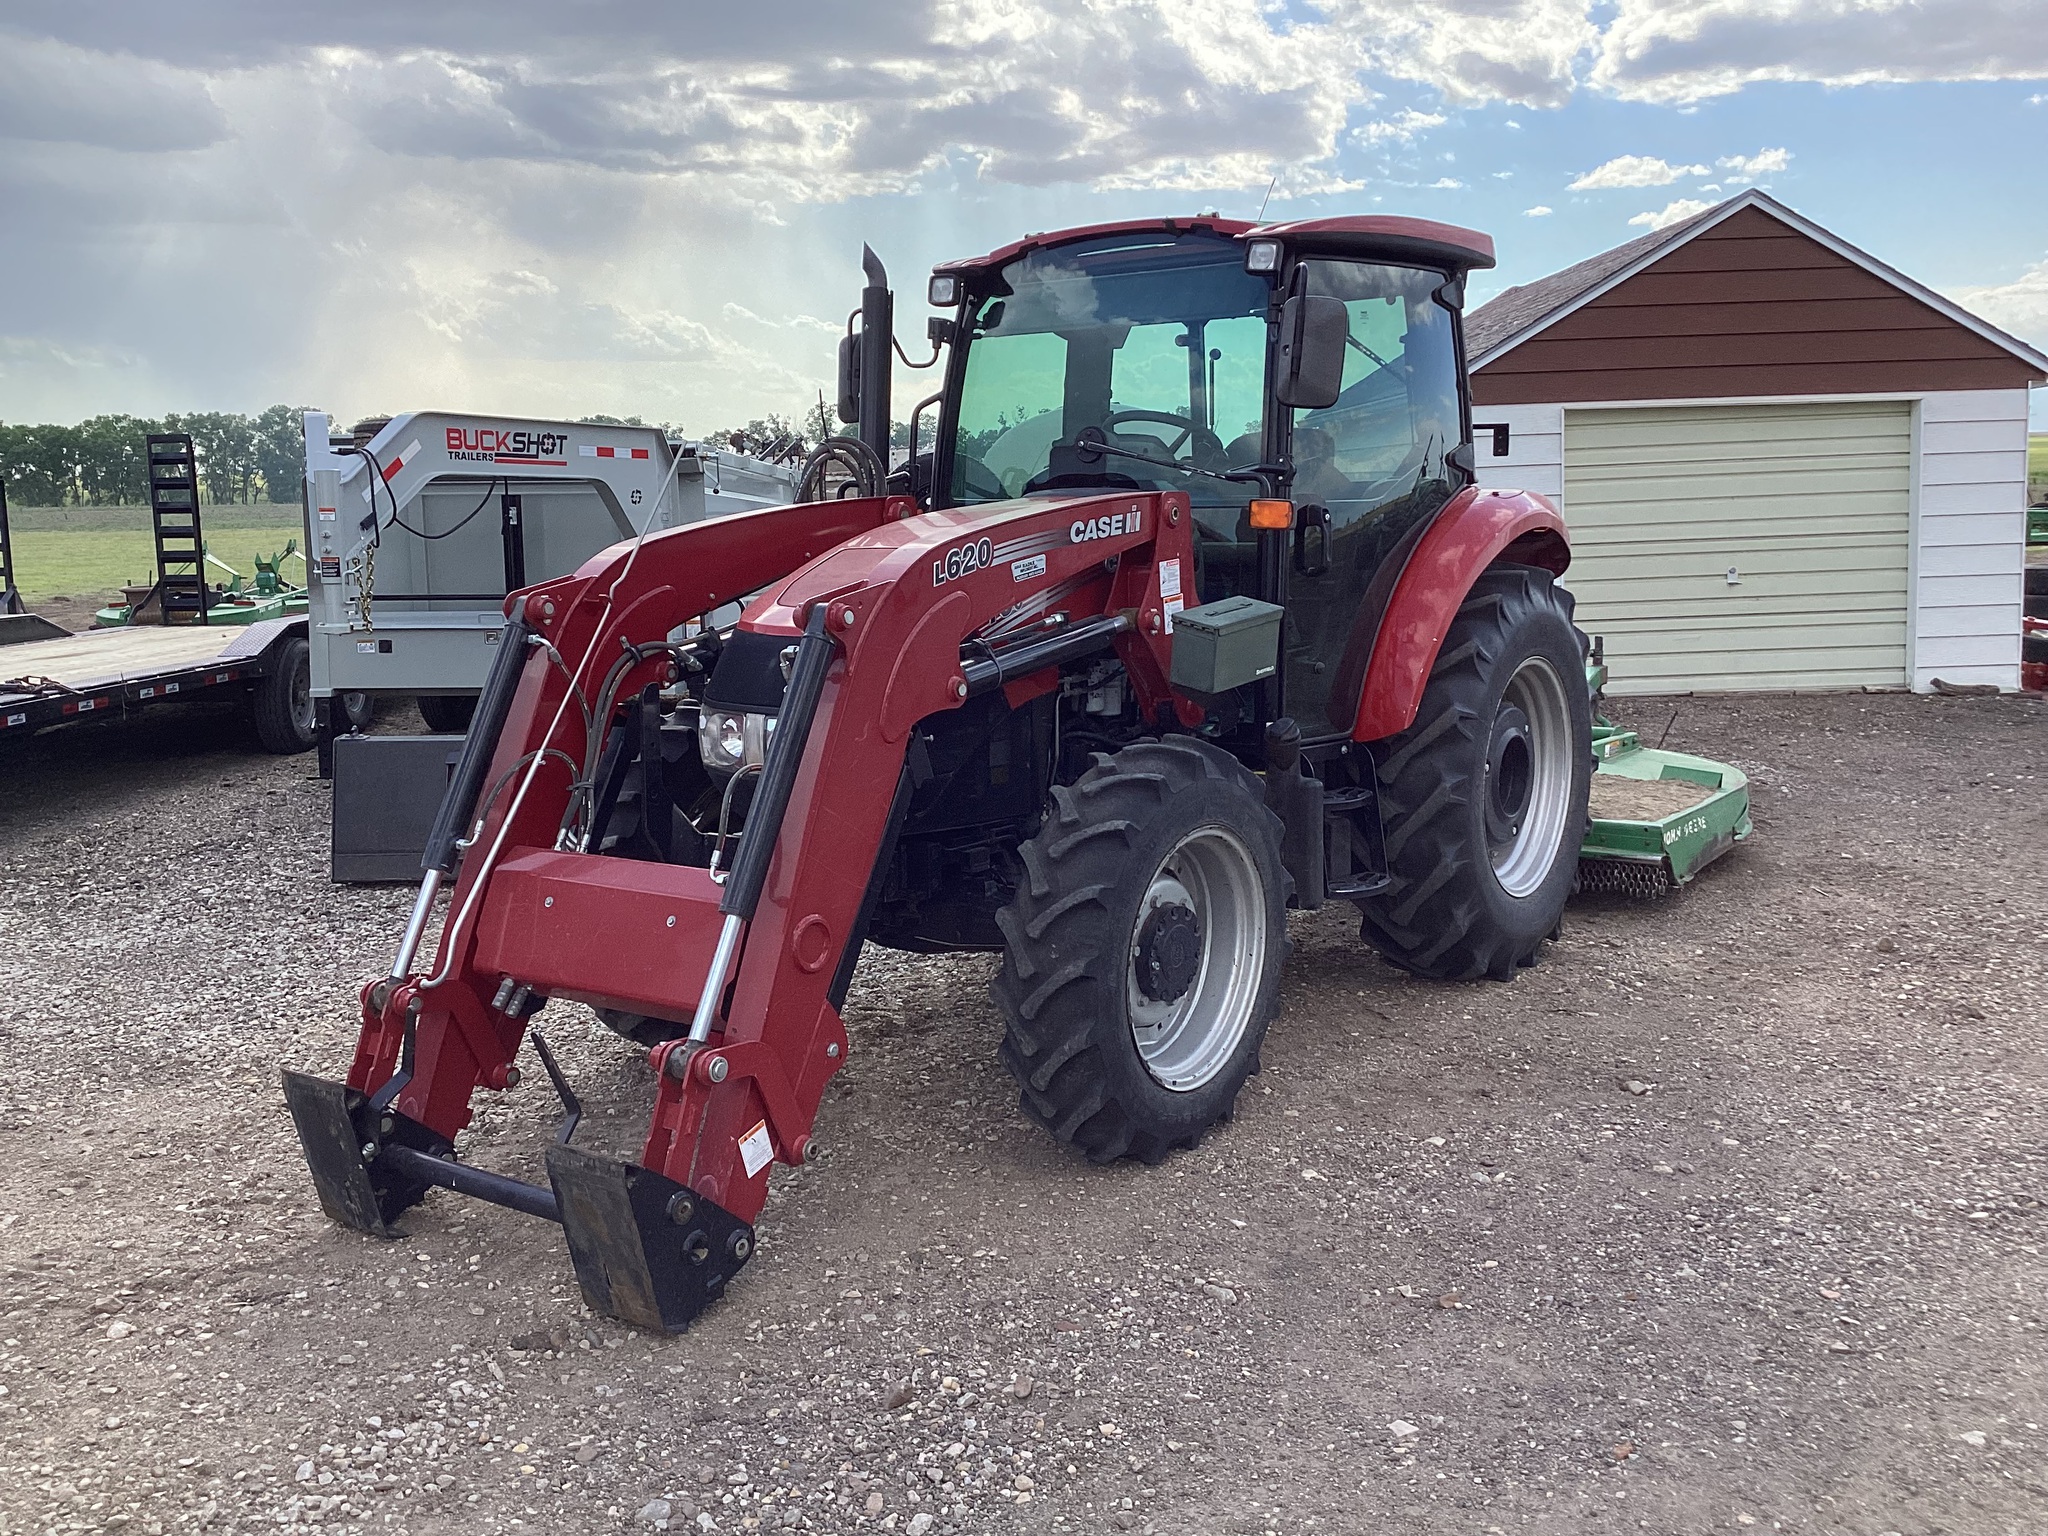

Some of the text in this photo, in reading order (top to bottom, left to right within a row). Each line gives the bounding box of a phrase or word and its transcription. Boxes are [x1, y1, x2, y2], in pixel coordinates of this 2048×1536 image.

[446, 427, 568, 457] BUCKSHOT
[447, 450, 494, 462] TRAILERS
[1070, 514, 1124, 543] CASE
[933, 537, 993, 587] L620
